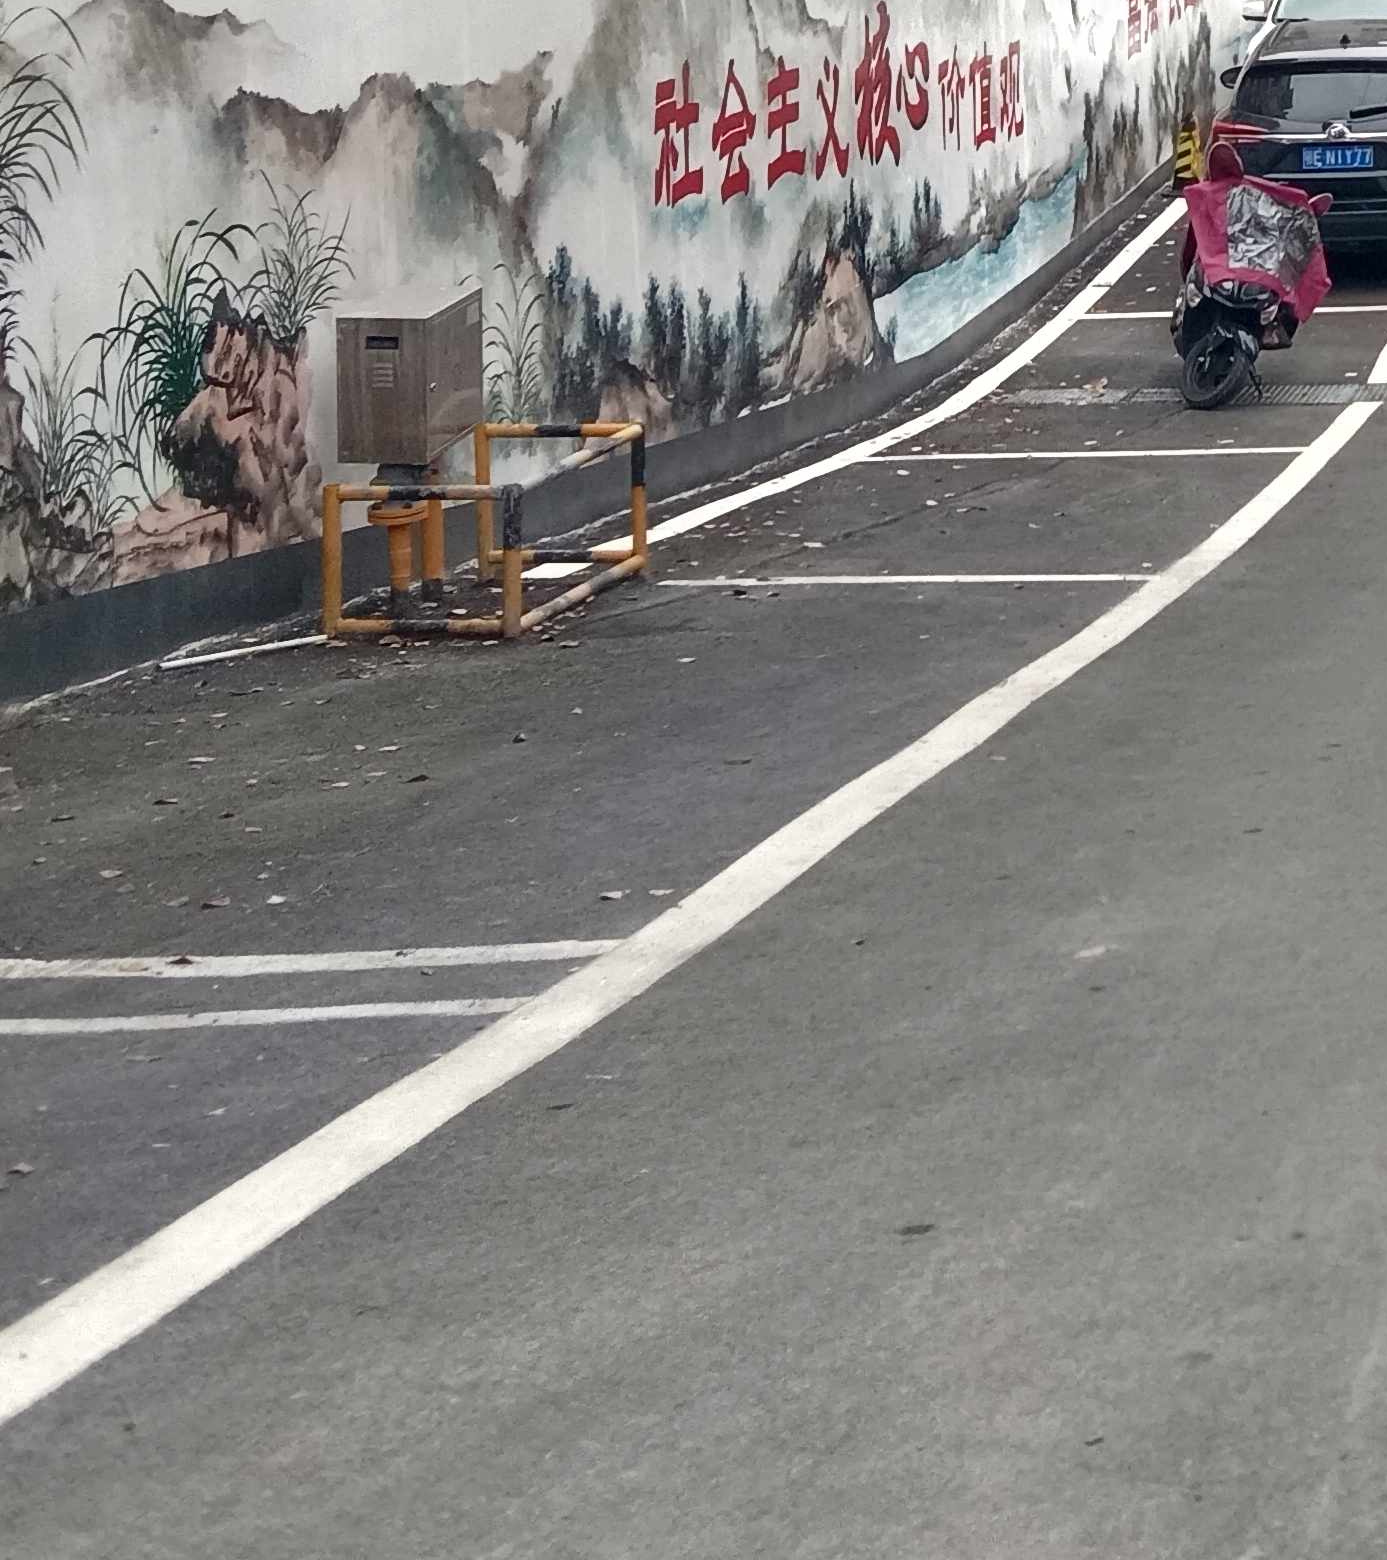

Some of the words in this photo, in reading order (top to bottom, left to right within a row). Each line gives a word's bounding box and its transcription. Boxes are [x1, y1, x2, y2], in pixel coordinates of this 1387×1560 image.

[654, 0, 1025, 208] 社会主义核心价值观
